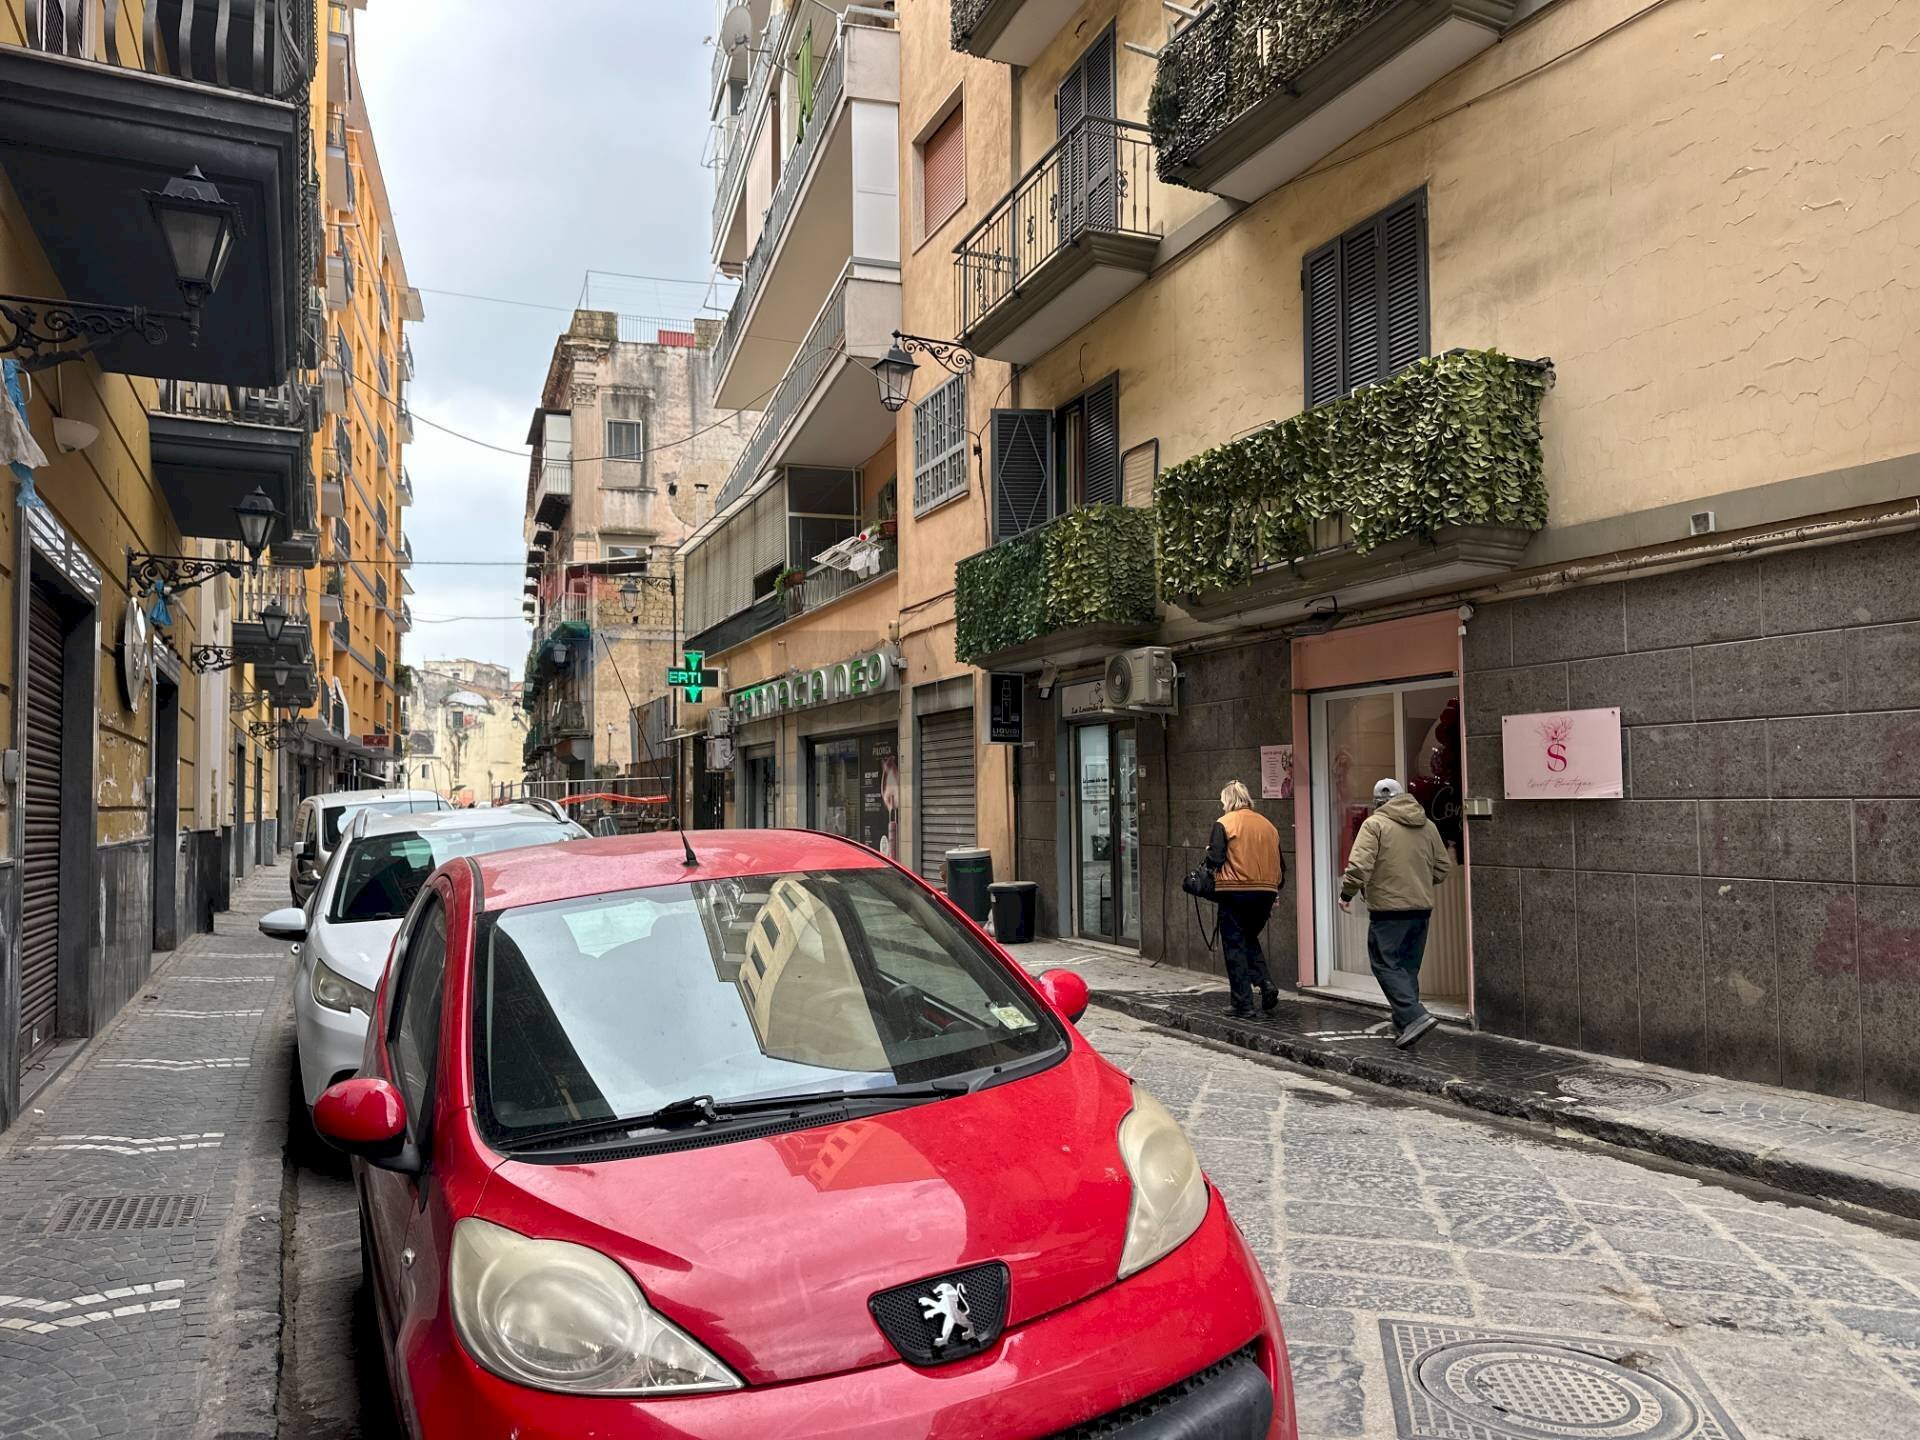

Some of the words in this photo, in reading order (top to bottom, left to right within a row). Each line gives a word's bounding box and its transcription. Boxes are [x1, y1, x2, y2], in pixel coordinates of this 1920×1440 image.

[668, 671, 702, 684] ERTI
[735, 671, 828, 721] FARMACIA
[833, 652, 886, 699] NEO
[992, 727, 1020, 735] LIQUIDI
[1547, 743, 1568, 772] S
